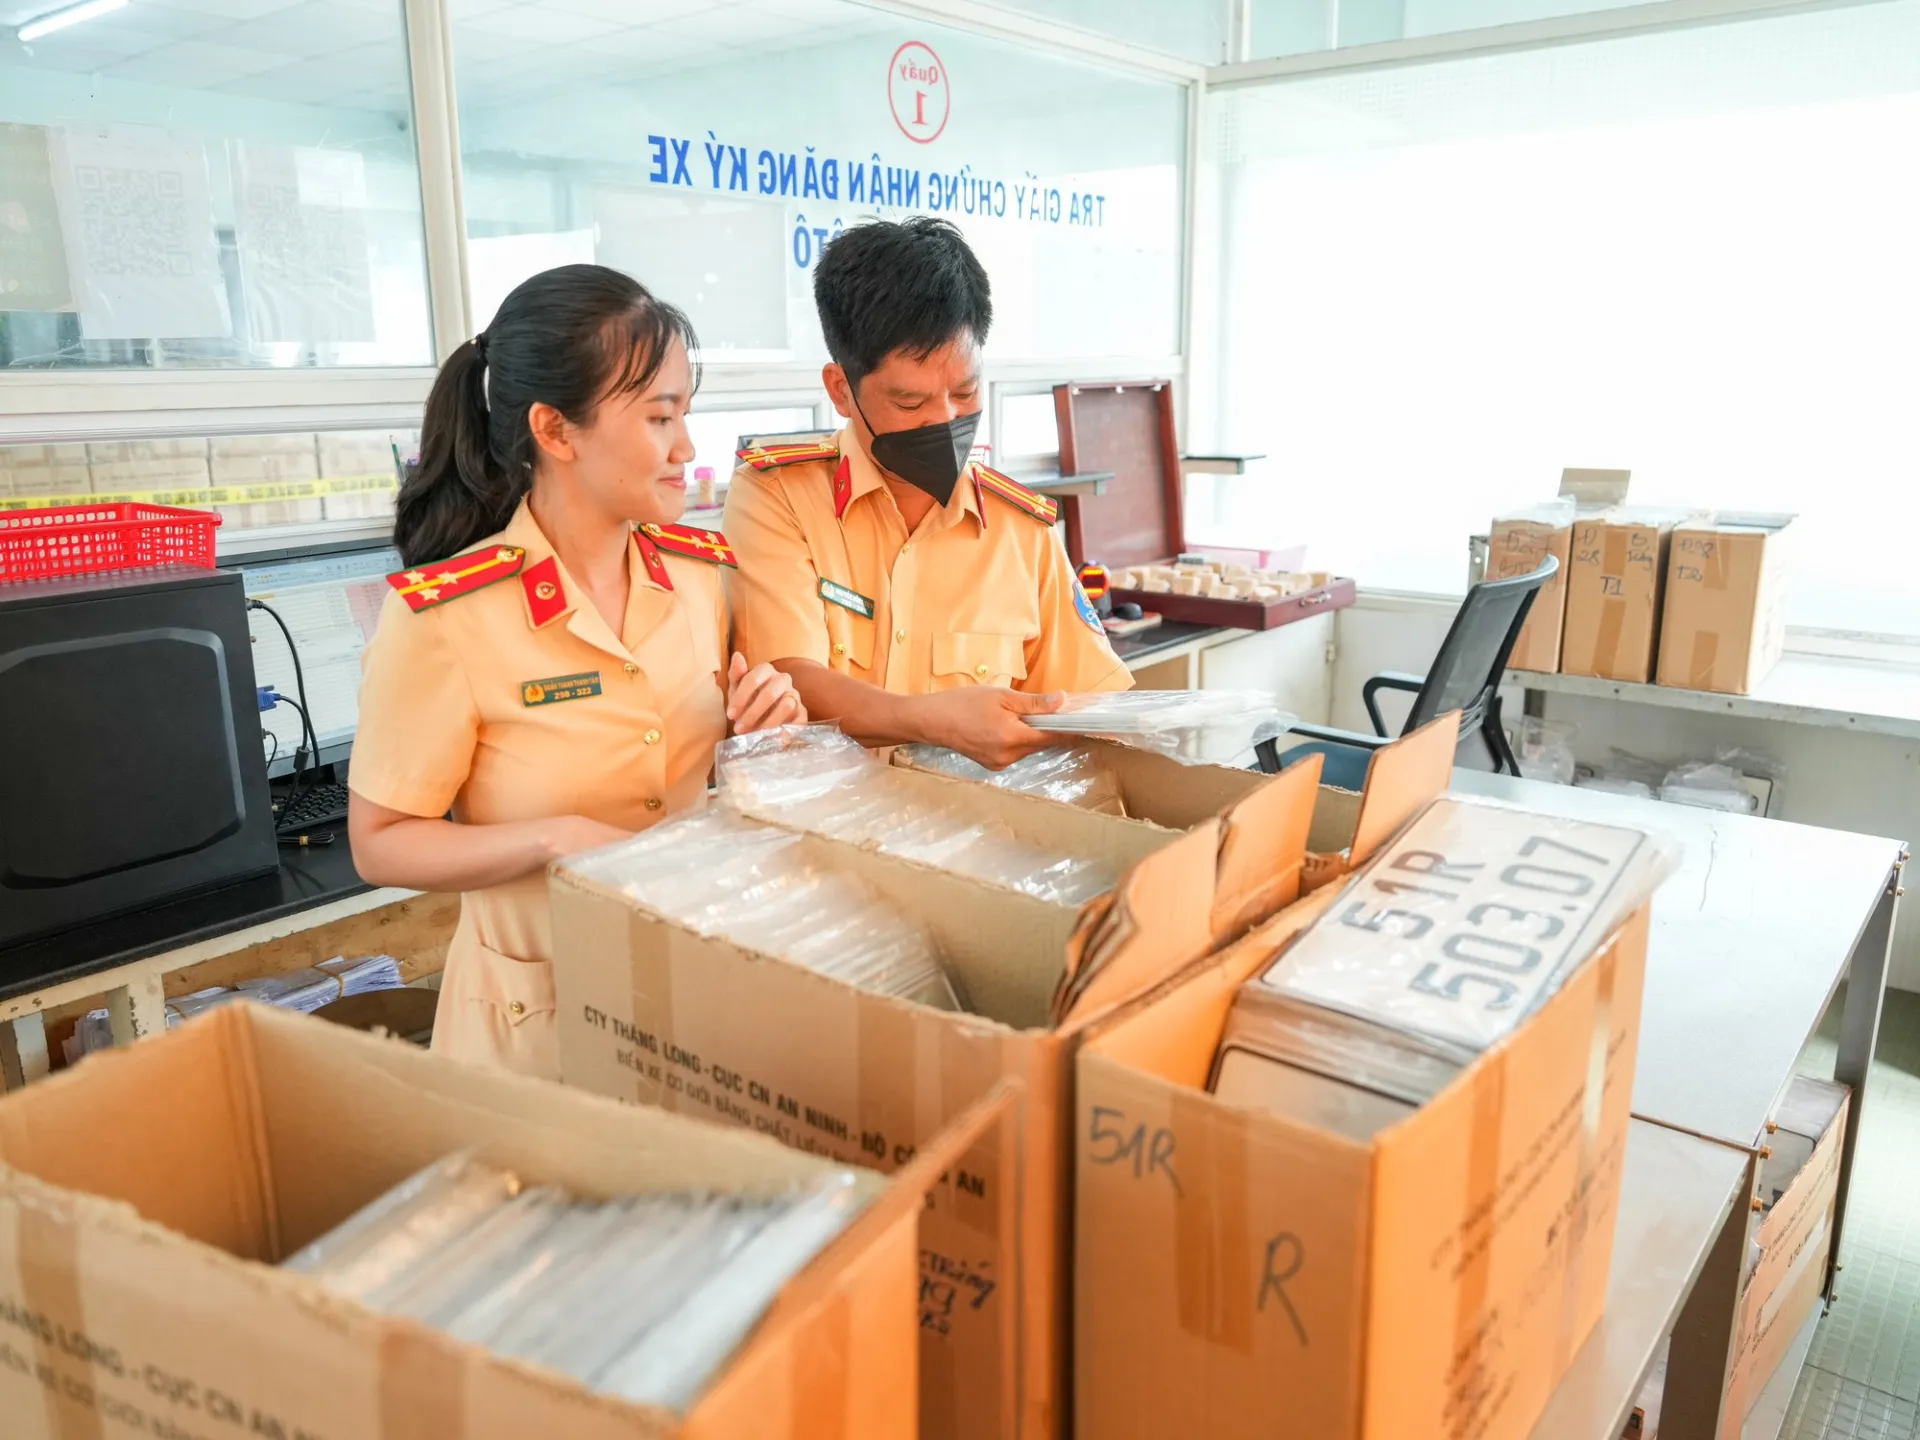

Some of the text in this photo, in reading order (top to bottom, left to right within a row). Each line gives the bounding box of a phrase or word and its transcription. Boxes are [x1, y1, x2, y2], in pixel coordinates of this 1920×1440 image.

[1599, 575, 1625, 596] T1
[1340, 849, 1486, 940] 51R
[1408, 835, 1611, 1011] 503.07
[584, 1004, 607, 1030] CTY
[663, 1041, 701, 1075] LONG
[748, 1079, 770, 1106] CN
[777, 1093, 799, 1119] AN
[805, 1105, 848, 1142] NINH
[957, 1170, 986, 1199] AN
[1089, 1105, 1186, 1199] 51R
[1256, 1231, 1310, 1347] R
